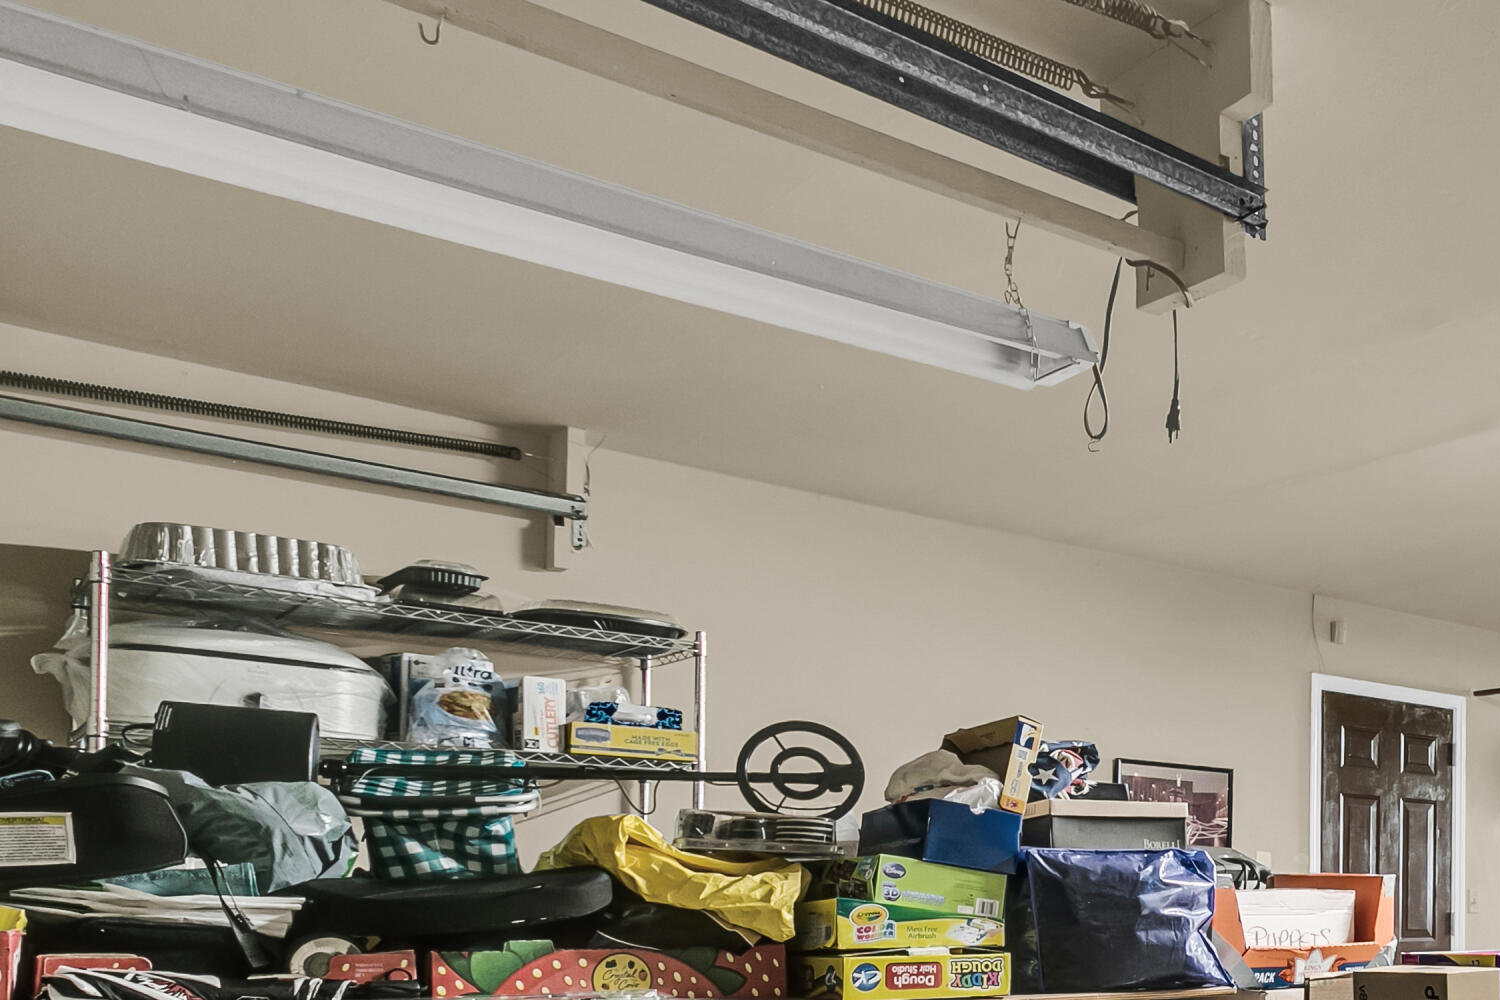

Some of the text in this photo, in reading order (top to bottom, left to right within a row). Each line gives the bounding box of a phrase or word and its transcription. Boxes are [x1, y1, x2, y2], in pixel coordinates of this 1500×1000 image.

[544, 696, 559, 749] CUTLERY
[906, 925, 922, 933] Mess
[907, 932, 937, 940] Airbrush
[1249, 925, 1331, 947] PUPPETS
[891, 964, 937, 974] Hair Studio
[951, 959, 1002, 974] DOUGH
[893, 974, 936, 988] Dough
[951, 972, 1000, 989] KIDDY
